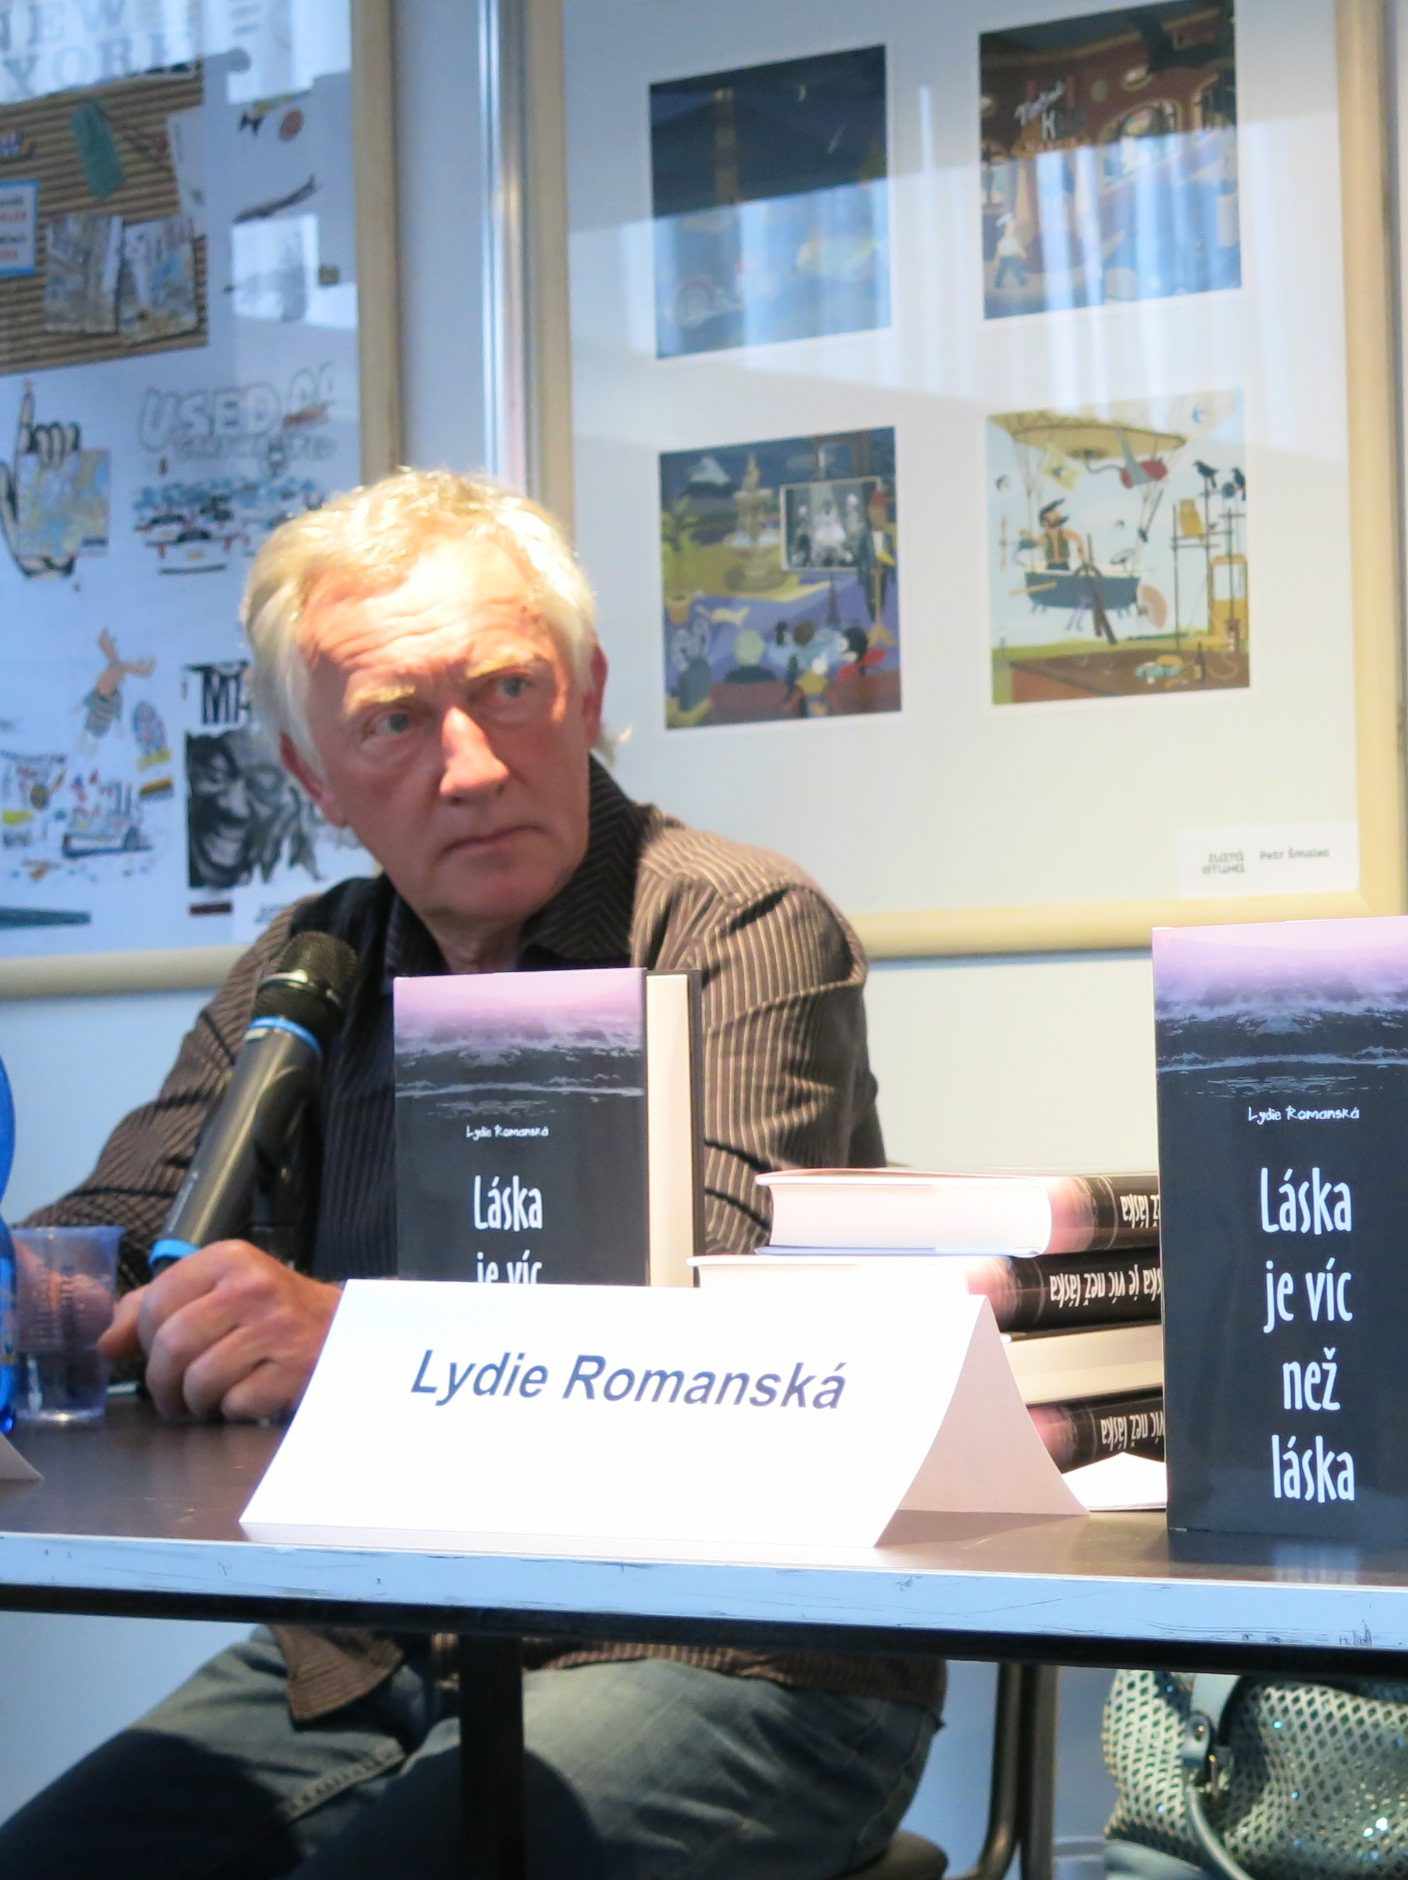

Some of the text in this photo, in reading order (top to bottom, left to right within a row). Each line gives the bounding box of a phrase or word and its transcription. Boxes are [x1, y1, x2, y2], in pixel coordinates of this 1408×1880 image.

[1248, 1105, 1360, 1125] Lydie Romanská
[474, 1175, 543, 1232] Láska
[1120, 1193, 1149, 1228] láska
[1260, 1167, 1352, 1235] Láska
[1050, 1274, 1081, 1308] láska
[1084, 1273, 1106, 1307] než
[1107, 1270, 1126, 1304] víc
[1129, 1264, 1140, 1301] je
[1263, 1257, 1353, 1334] je víc
[411, 1349, 849, 1410] Lydie Romanská
[1283, 1347, 1341, 1411] než
[1101, 1416, 1128, 1450] láska
[1130, 1413, 1149, 1448] než
[1271, 1434, 1355, 1503] láska
